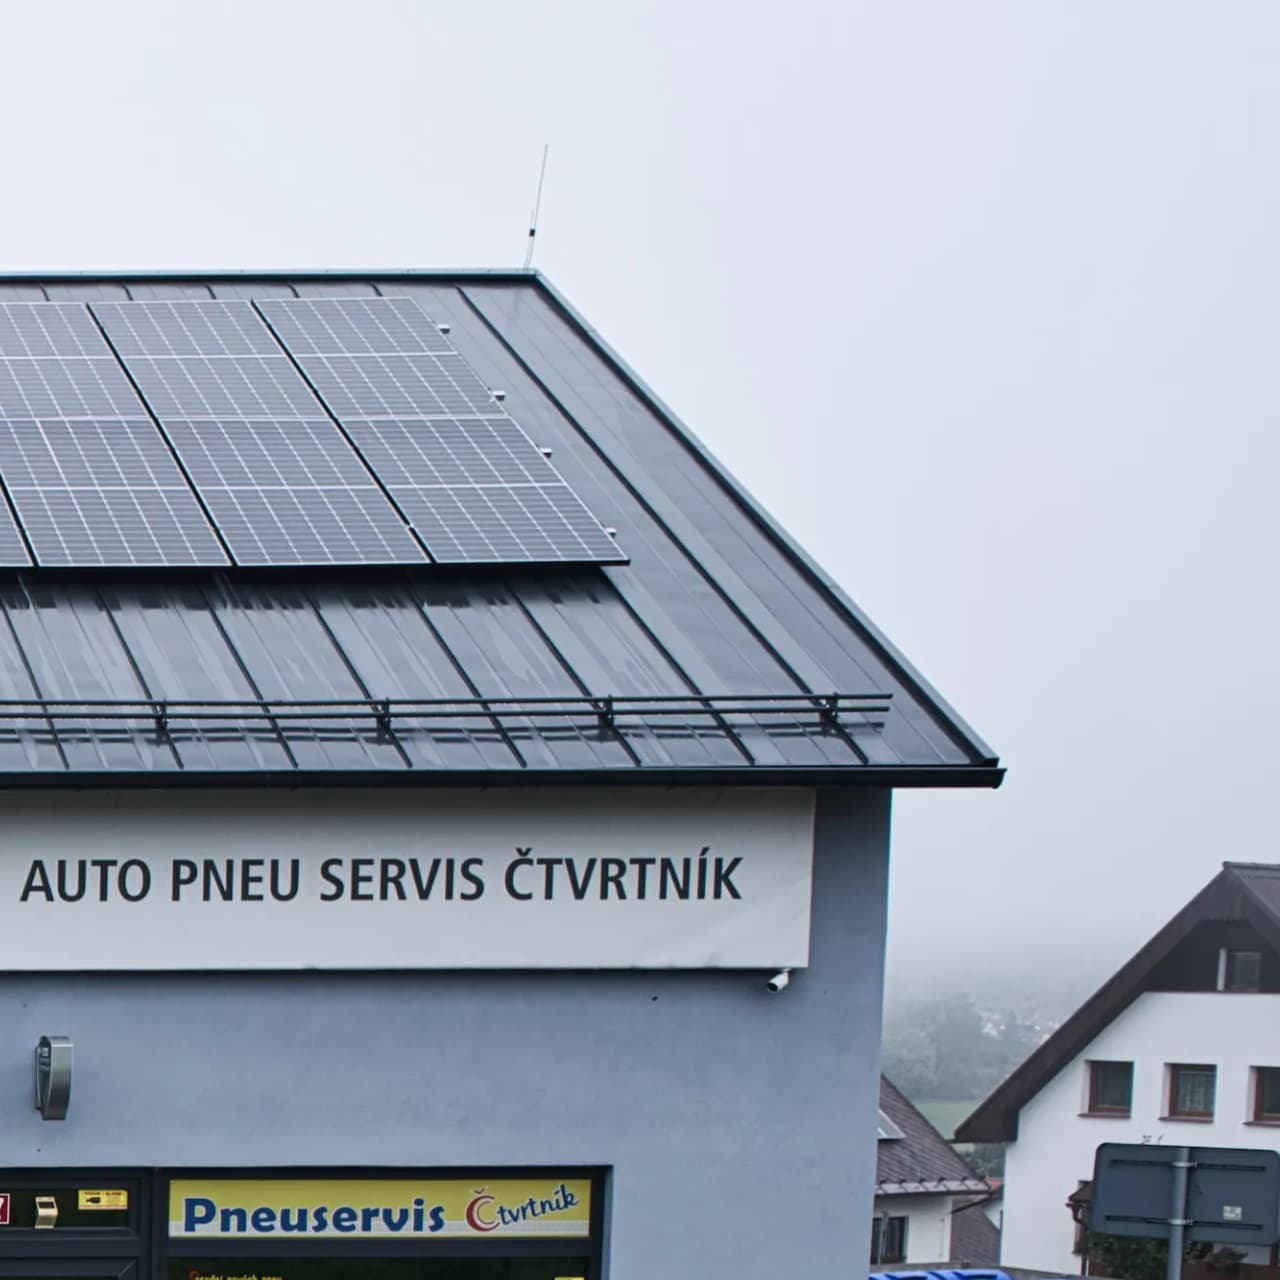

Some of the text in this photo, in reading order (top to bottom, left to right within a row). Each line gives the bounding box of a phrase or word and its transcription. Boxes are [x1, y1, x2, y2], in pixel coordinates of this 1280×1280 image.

[20, 847, 743, 903] AUTO PNEU SERVIS ČTVRTNÍK
[183, 1184, 579, 1234] Pneuservis Čtvrtník
